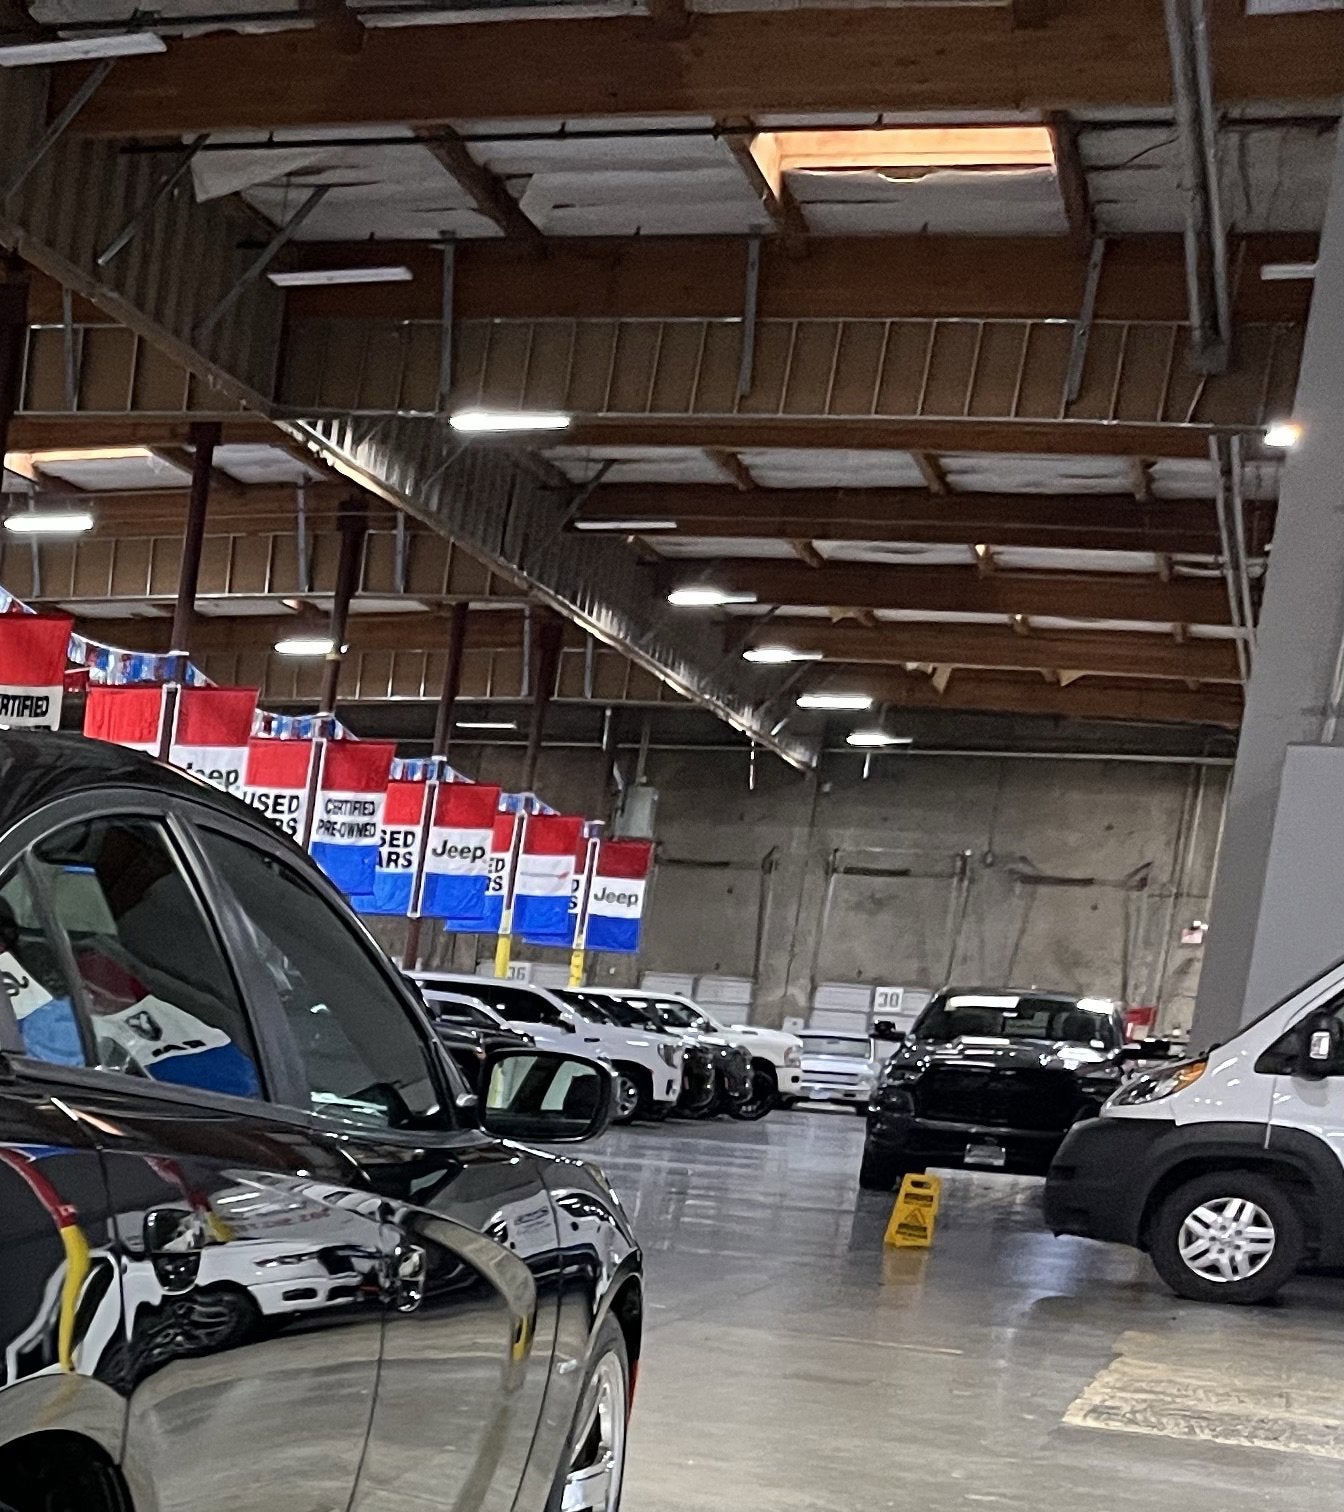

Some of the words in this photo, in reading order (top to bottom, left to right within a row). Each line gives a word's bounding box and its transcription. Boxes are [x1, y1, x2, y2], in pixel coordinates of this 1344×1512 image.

[243, 790, 300, 817] USED
[324, 798, 376, 816] CERTIFIED
[316, 819, 377, 839] PRE-OWNED
[379, 829, 416, 848] SED
[378, 850, 413, 869] RS
[431, 839, 486, 863] Jeep
[593, 886, 639, 908] Jeep
